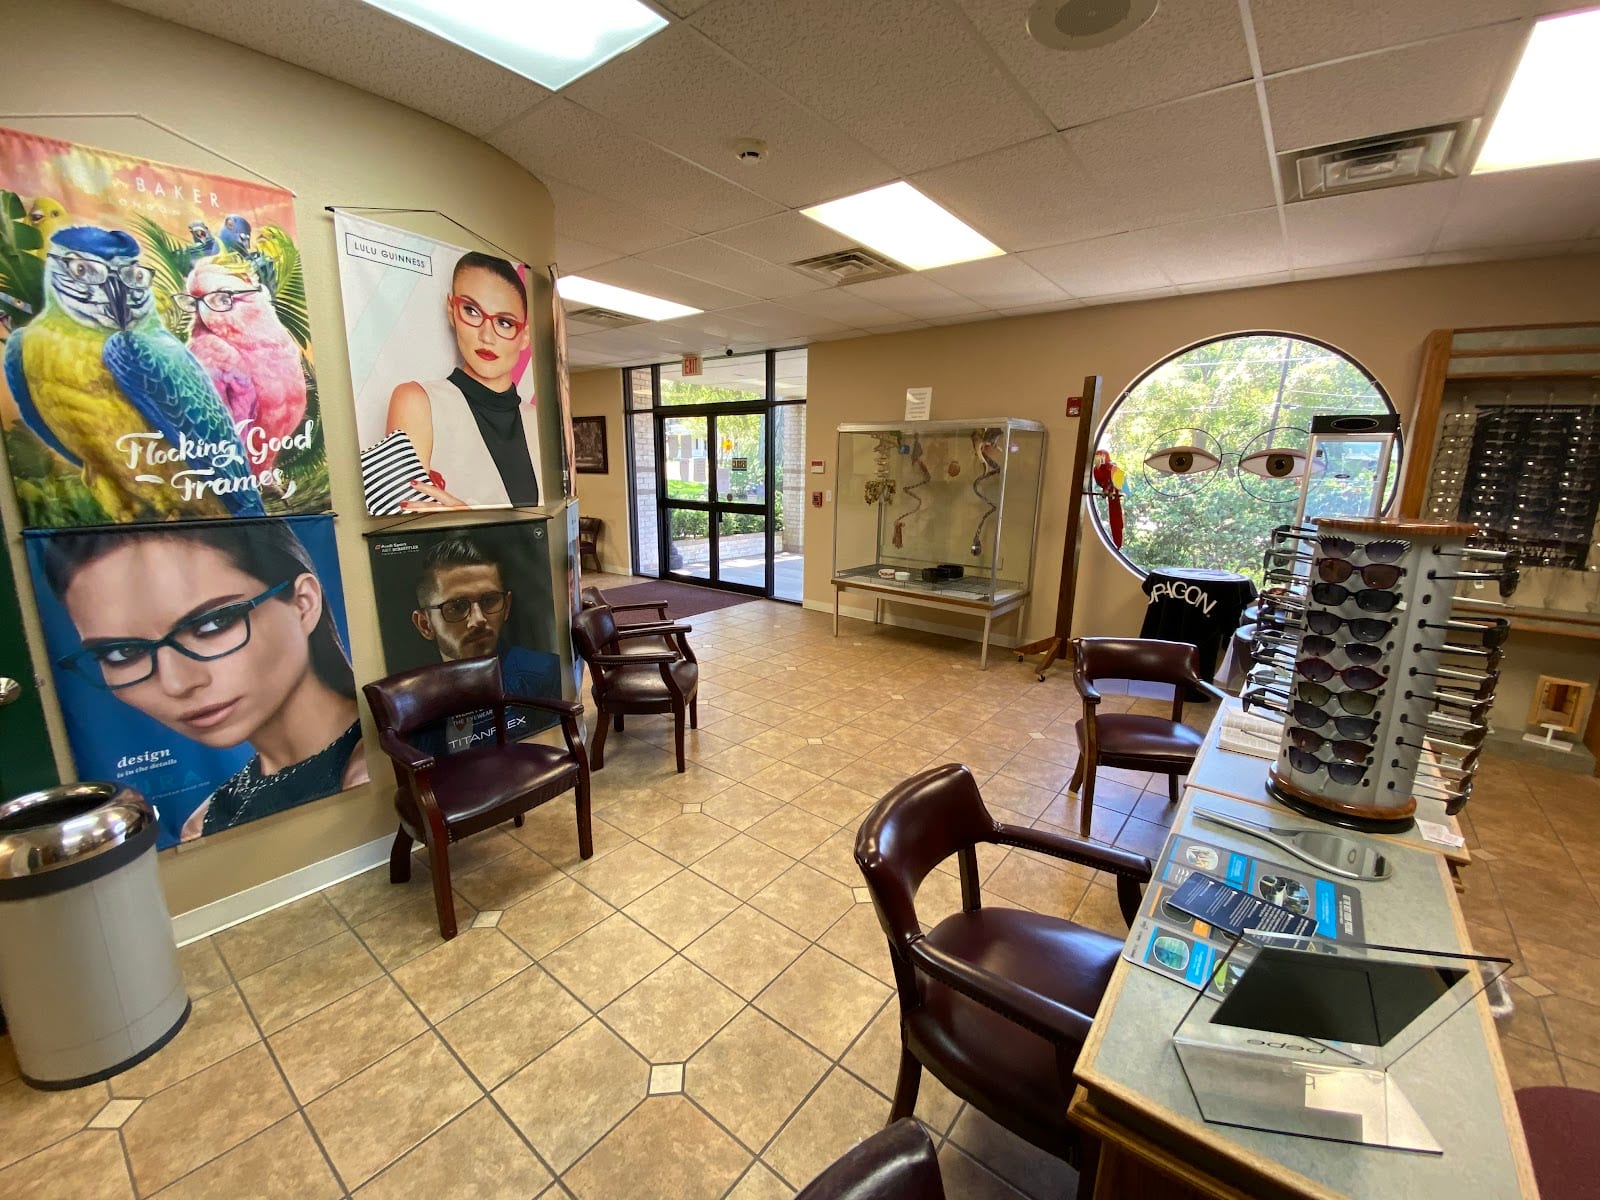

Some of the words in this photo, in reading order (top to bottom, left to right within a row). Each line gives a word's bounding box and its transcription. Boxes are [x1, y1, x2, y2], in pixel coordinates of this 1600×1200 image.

[136, 177, 219, 208] BAKER
[354, 241, 377, 255] LULU
[381, 250, 425, 268] GUINNESS
[684, 357, 698, 375] EXIT
[115, 430, 244, 470] Flocking
[235, 419, 314, 464] Good
[447, 715, 527, 749] TITANFEX
[117, 748, 171, 769] design
